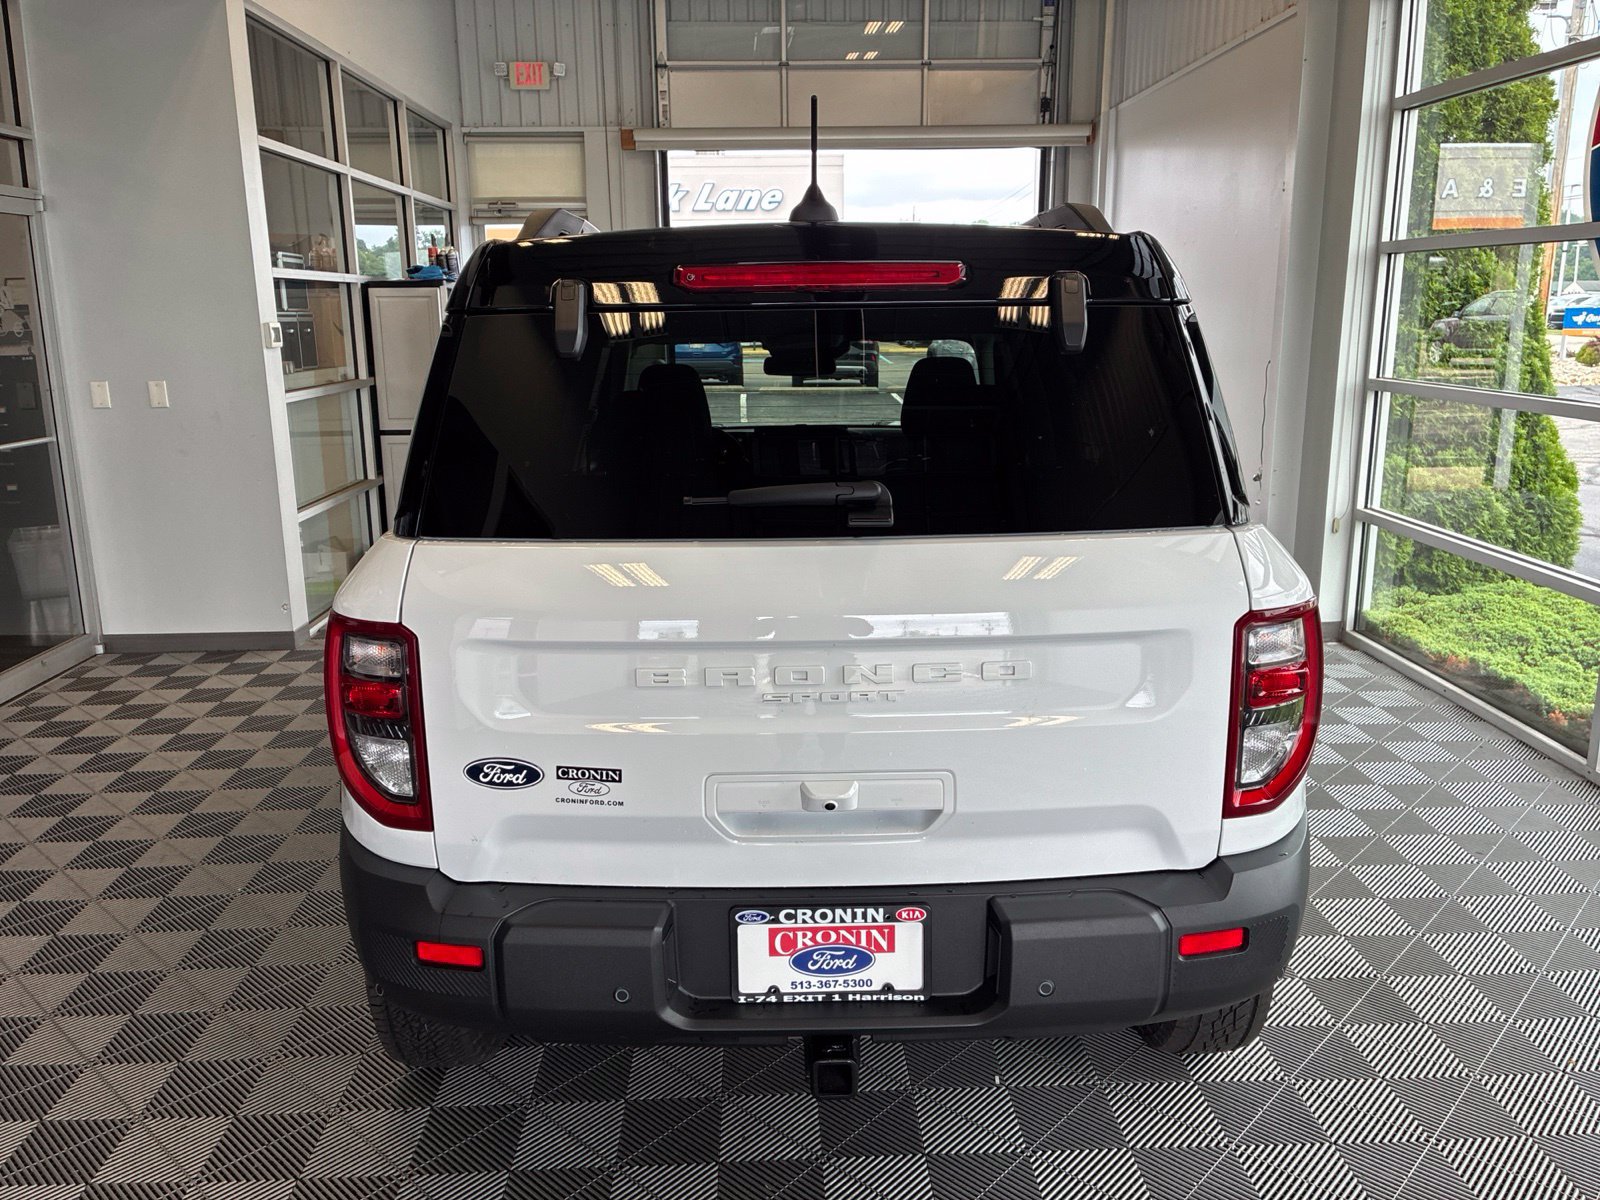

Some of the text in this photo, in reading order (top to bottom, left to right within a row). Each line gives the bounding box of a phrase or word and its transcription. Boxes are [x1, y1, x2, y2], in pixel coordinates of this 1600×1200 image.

[515, 63, 544, 85] EXIT
[692, 182, 784, 213] Lane
[635, 660, 1033, 687] BRONCO
[761, 690, 905, 704] SPORT
[479, 763, 528, 784] Ford
[557, 767, 620, 782] CRONIN
[576, 782, 603, 795] Ford
[555, 797, 625, 807] CRONINFORD.COM
[742, 913, 763, 922] Ford
[778, 907, 884, 924] CRONIN
[901, 912, 922, 920] KIA
[774, 928, 890, 955] CRONIN
[807, 950, 858, 970] Ford
[790, 978, 874, 990] 513-367-5300
[738, 992, 925, 1004] I-74 EXIT 1 Harrison
